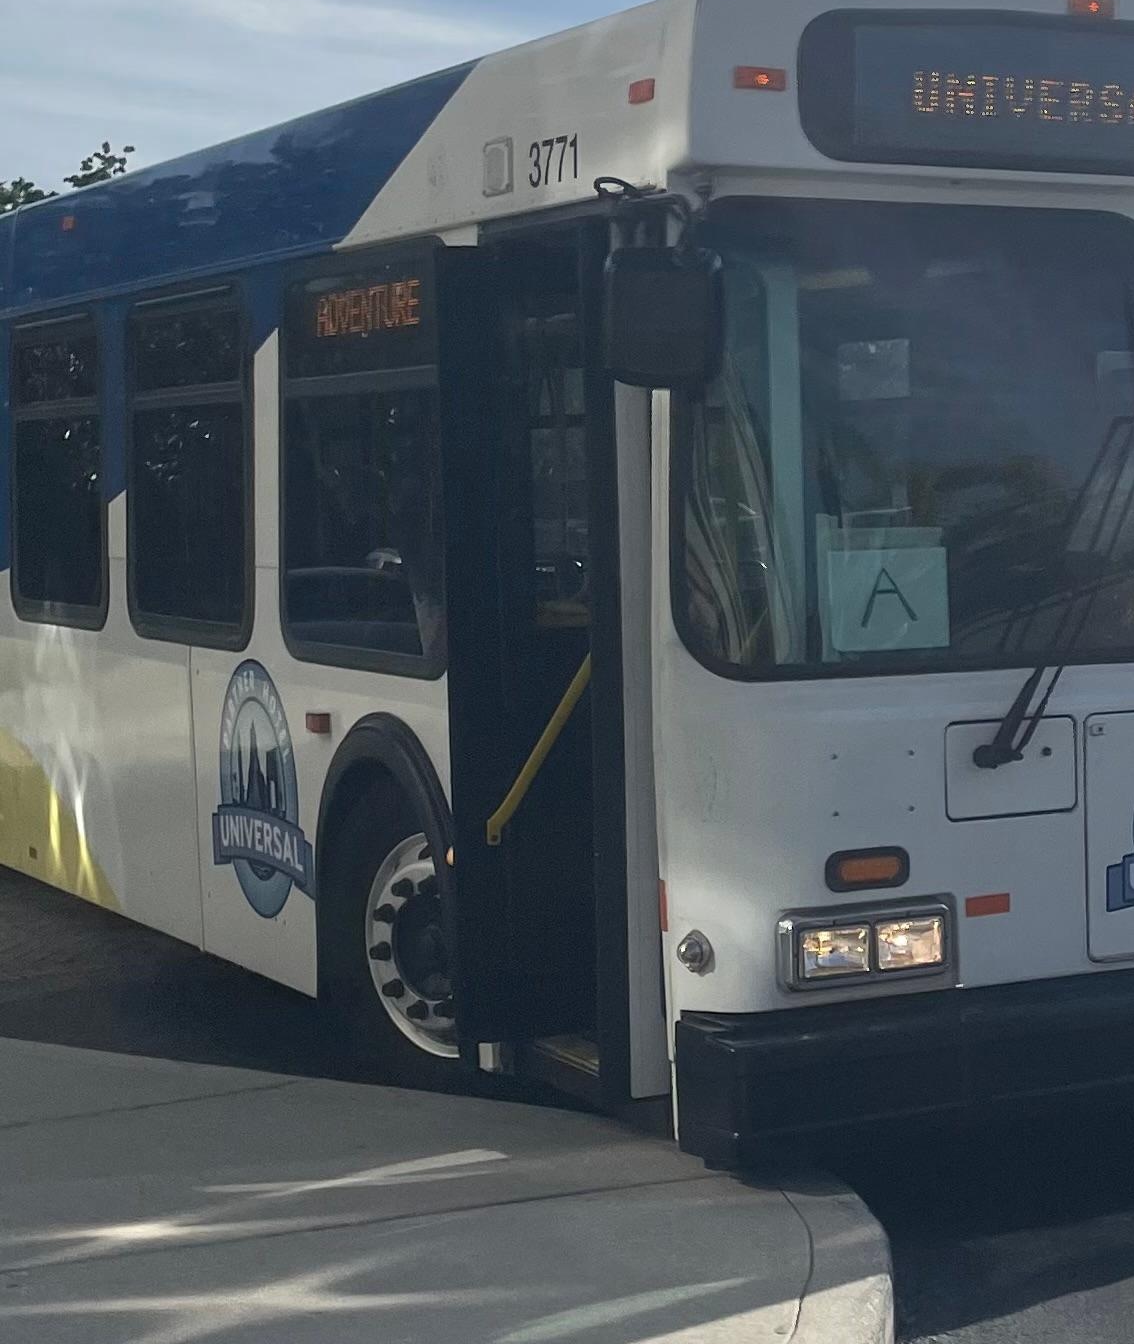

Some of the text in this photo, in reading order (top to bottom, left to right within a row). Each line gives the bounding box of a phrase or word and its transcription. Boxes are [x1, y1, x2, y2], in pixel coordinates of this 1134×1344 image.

[528, 132, 578, 188] 3771
[316, 279, 420, 337] ADVENTURE
[861, 567, 918, 628] A
[219, 814, 304, 872] UNIVERSAL
